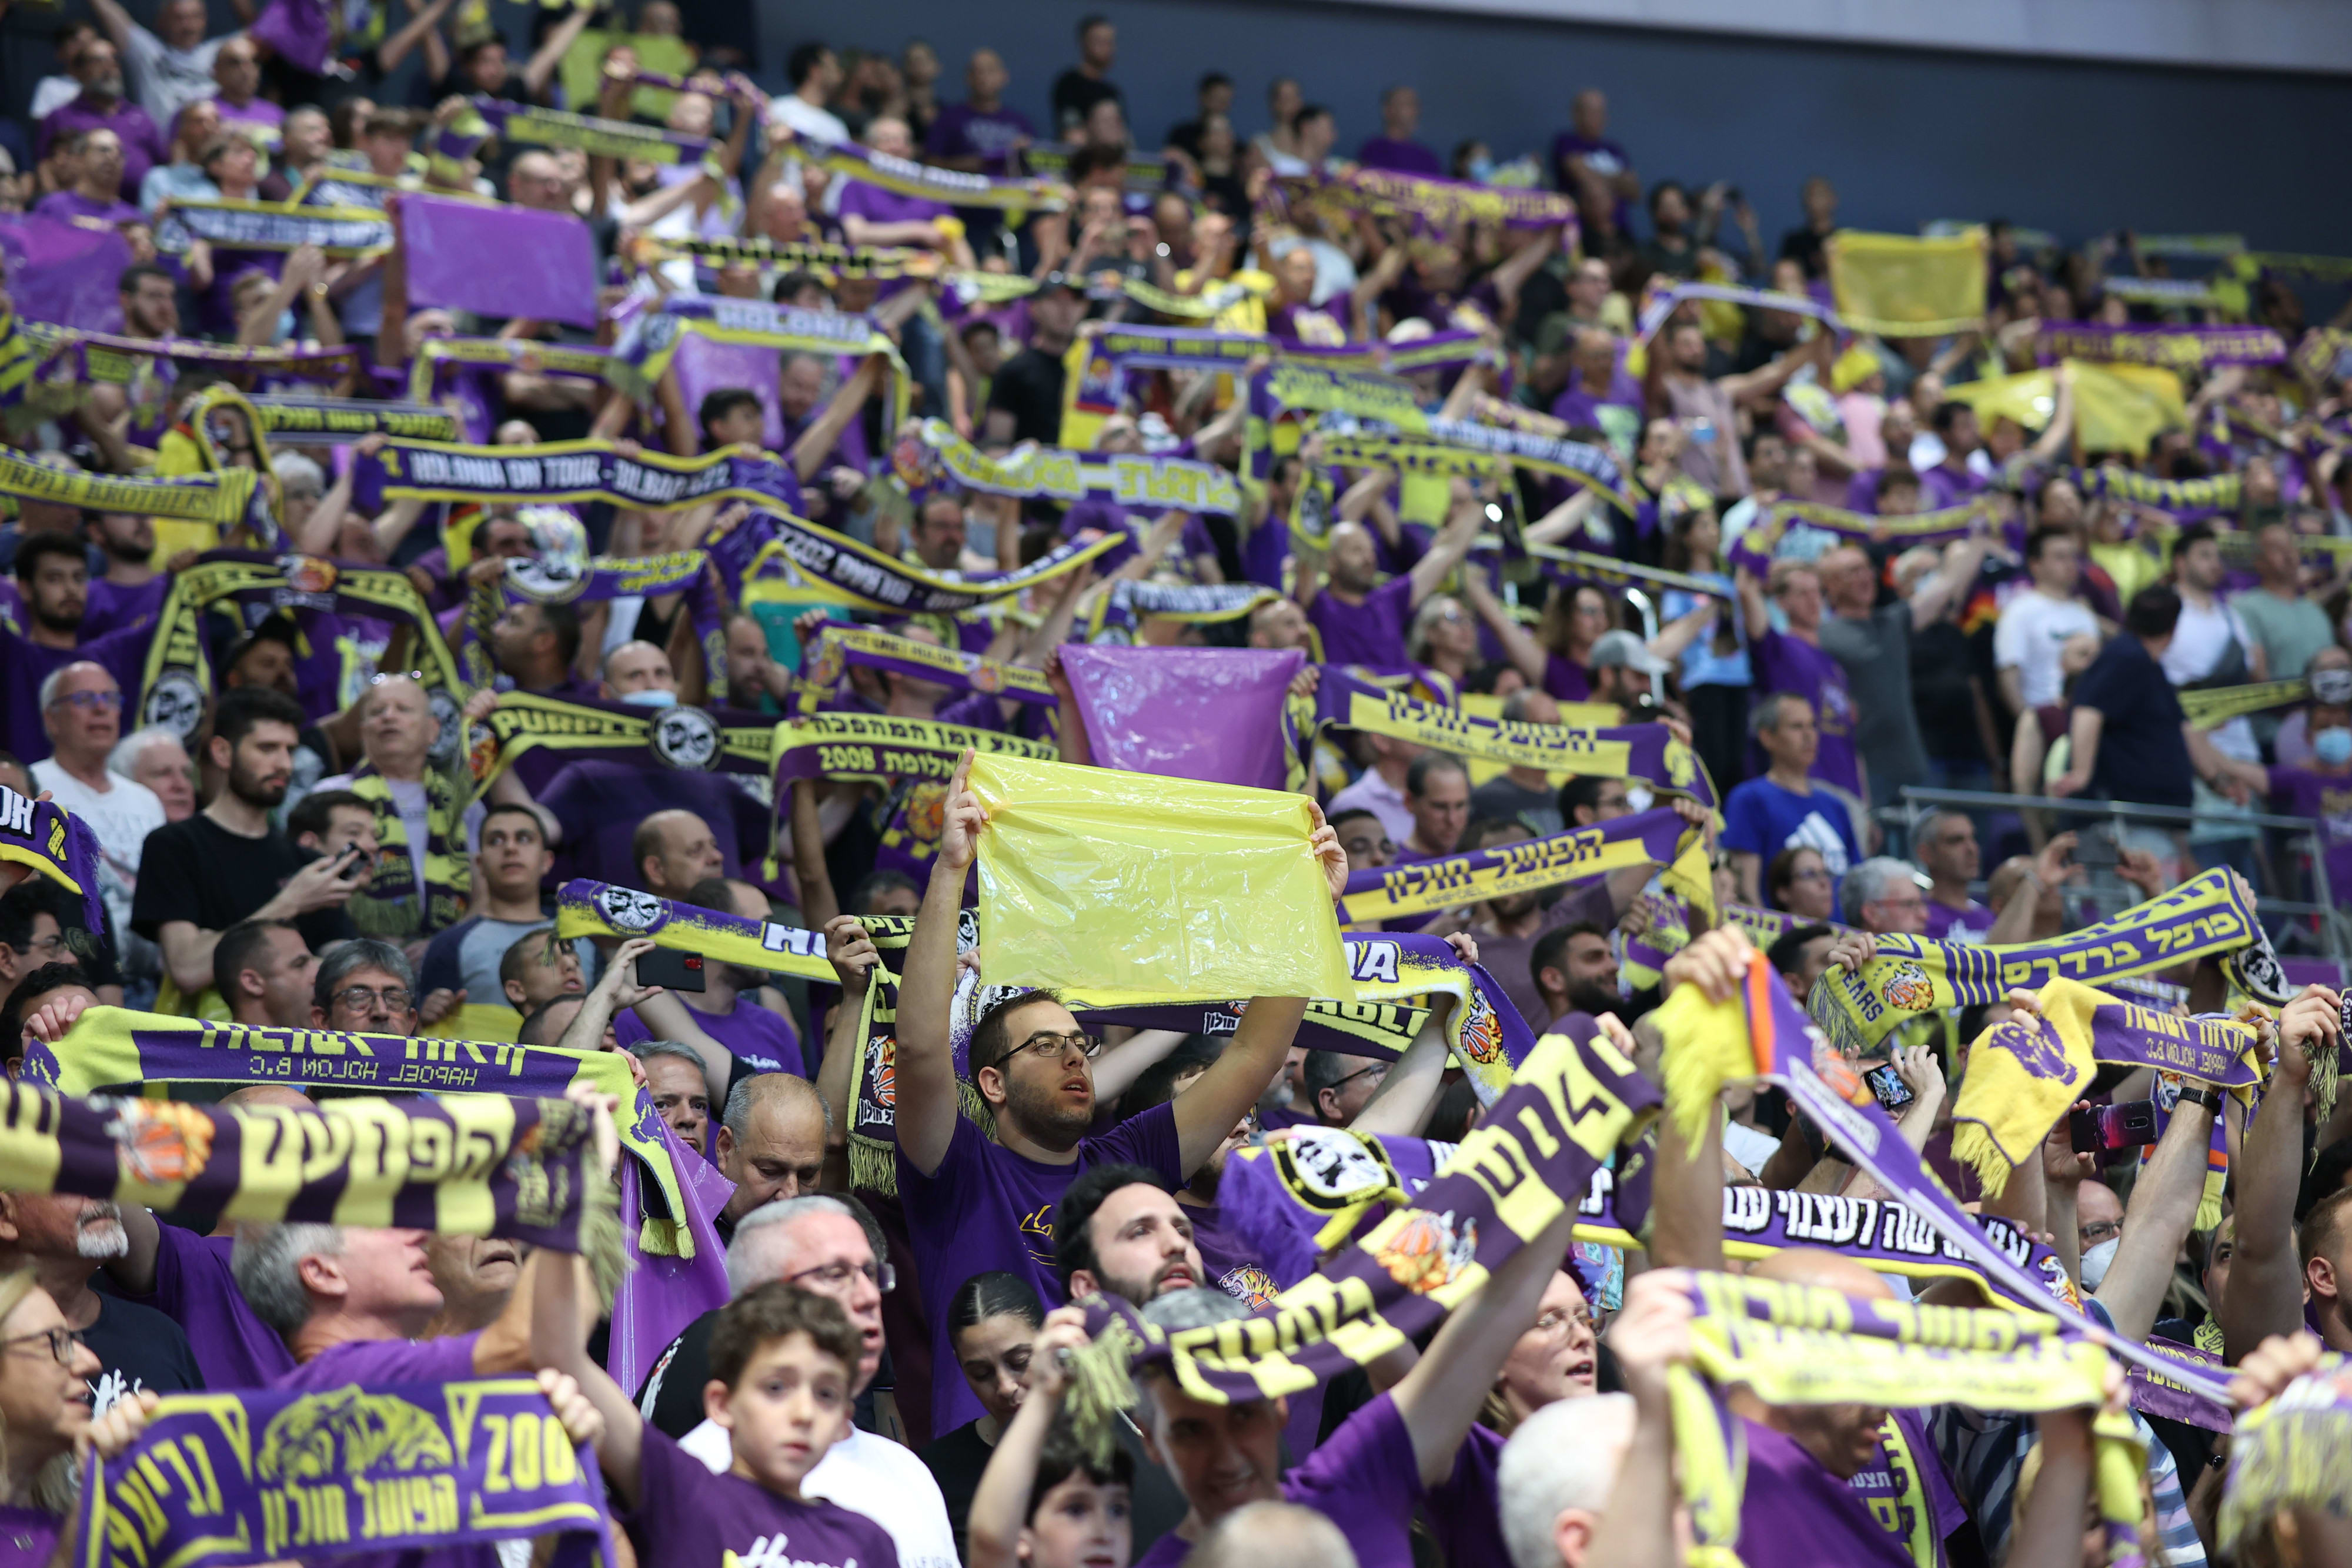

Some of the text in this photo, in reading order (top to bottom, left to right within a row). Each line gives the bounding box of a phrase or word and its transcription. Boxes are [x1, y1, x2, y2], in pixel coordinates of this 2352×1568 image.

[714, 302, 870, 342] HOLONIA
[543, 455, 601, 487] TOUR
[490, 708, 643, 740] PURPLE
[817, 744, 876, 771] 2008
[1383, 828, 1605, 904] הפועל חולון
[2002, 911, 2241, 985] פרפל ברדרס
[1839, 967, 1884, 1022] EARS
[481, 1412, 587, 1494] 200
[259, 1473, 459, 1559] הפועל חולון
